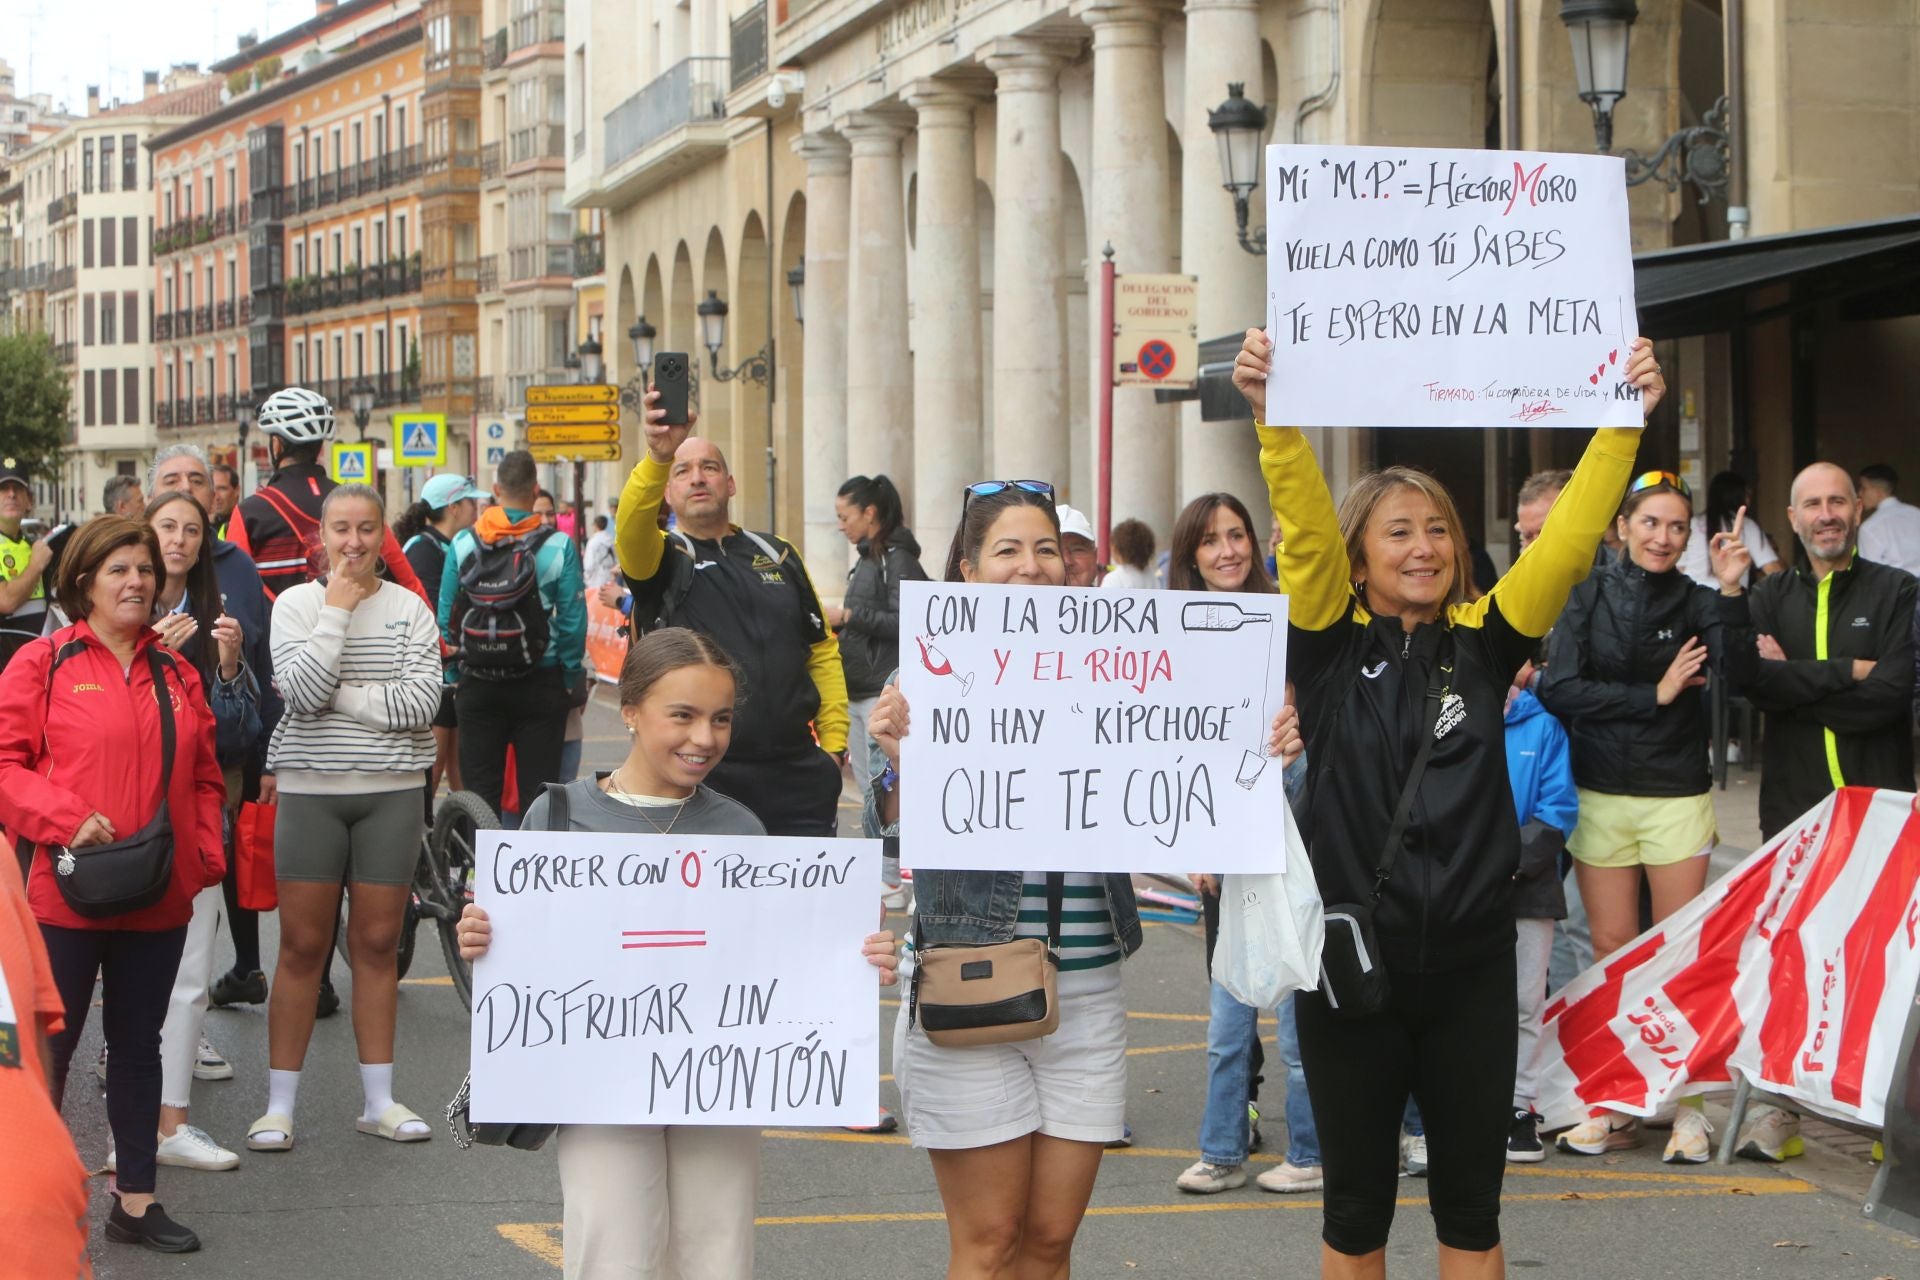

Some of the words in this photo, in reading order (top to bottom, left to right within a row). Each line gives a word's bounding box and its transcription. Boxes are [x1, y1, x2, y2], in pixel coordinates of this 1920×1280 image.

[1286, 238, 1356, 272] VUELA
[1363, 236, 1419, 269] COMO
[1447, 224, 1566, 281] SABES
[1128, 307, 1188, 317] GOBIERNO
[1147, 296, 1169, 306] DEL
[1327, 299, 1421, 346] ESPERO
[1431, 303, 1465, 336] EN
[1472, 303, 1508, 335] LA
[1557, 388, 1569, 398] DE
[1573, 384, 1597, 398] VIDA
[1615, 382, 1640, 401] KM
[926, 595, 979, 636] CON
[1002, 596, 1039, 636] LA
[993, 648, 1011, 685] Y
[1033, 651, 1073, 681] EL
[932, 707, 970, 744] NO
[991, 707, 1045, 744] HAY
[942, 767, 1027, 834] QUE
[1058, 768, 1101, 831] TE
[493, 842, 608, 894] CORRER
[617, 853, 669, 886] CON
[1651, 1005, 1677, 1034] sport
[648, 1030, 847, 1115] MONTÓN
